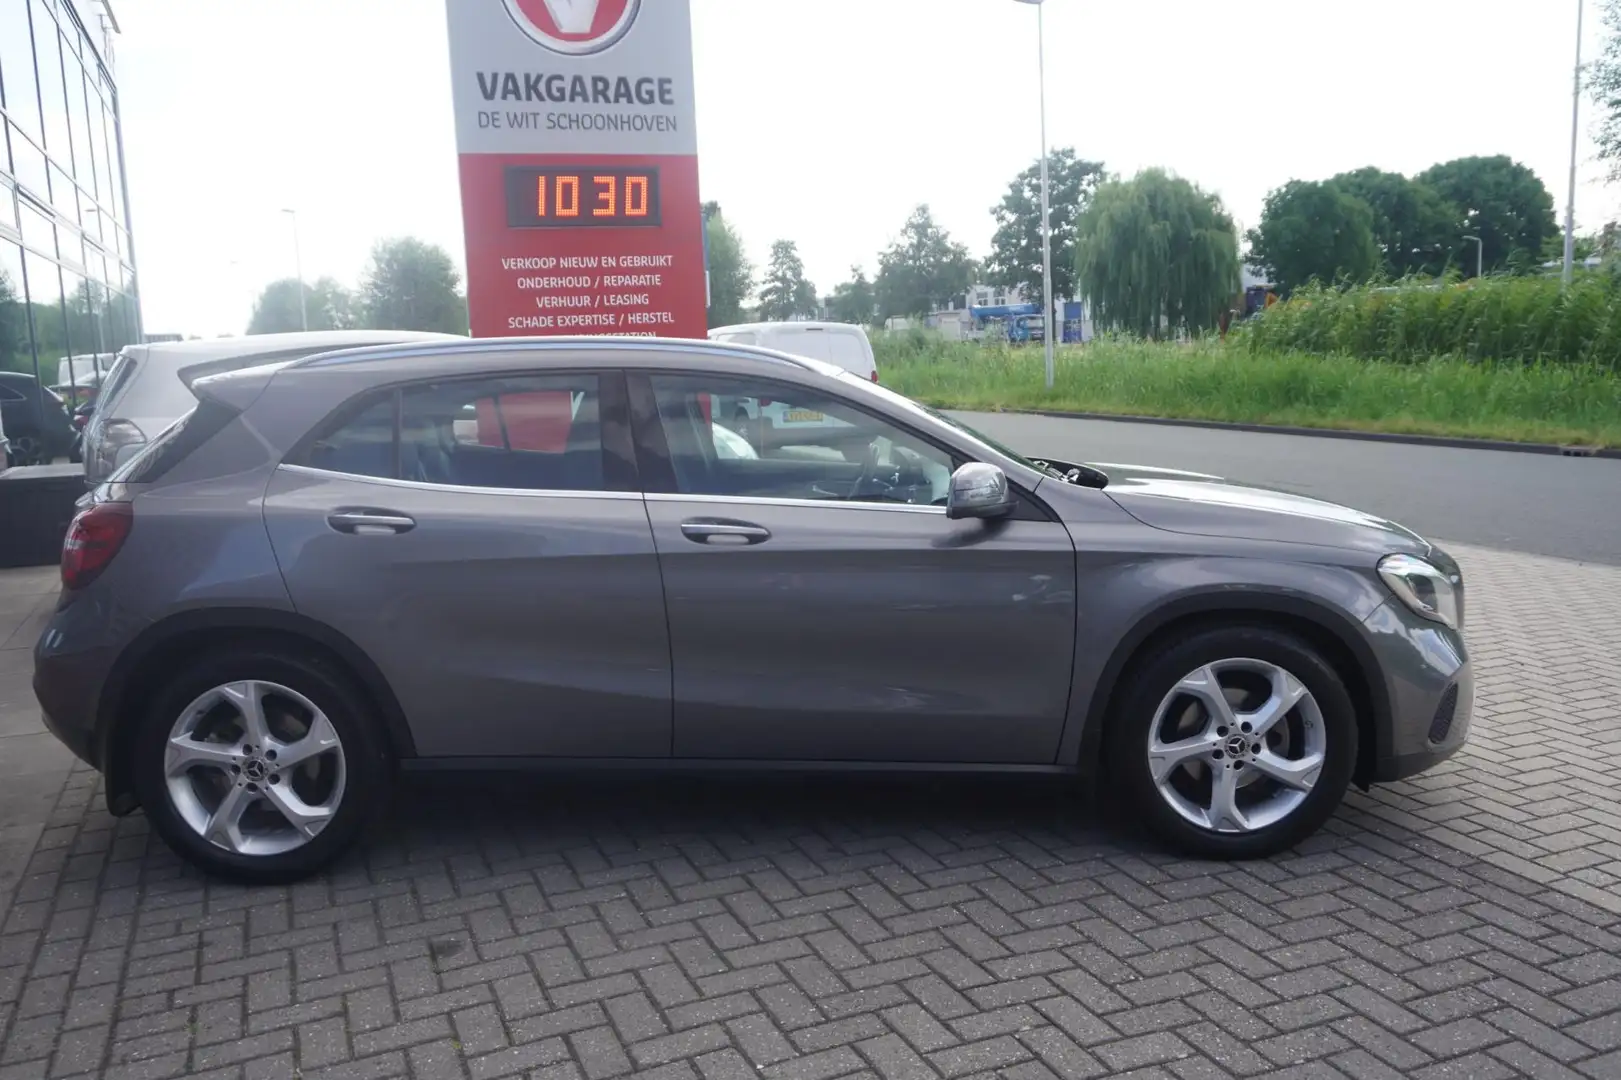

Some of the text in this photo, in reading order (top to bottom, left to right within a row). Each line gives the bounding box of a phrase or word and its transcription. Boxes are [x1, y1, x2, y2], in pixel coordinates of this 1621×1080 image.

[476, 71, 675, 105] VAKGARAGE
[478, 111, 678, 132] DE WIT SCHOONHOVEN
[501, 255, 673, 270] VERKOOP NIEUW EN GEBRUIKT
[517, 274, 662, 289] ONDERHOUD / REPARATIE
[536, 293, 649, 308] VERHUUR / LEASING
[508, 312, 675, 329] SCHADE EXPERTISE / HERSTEL
